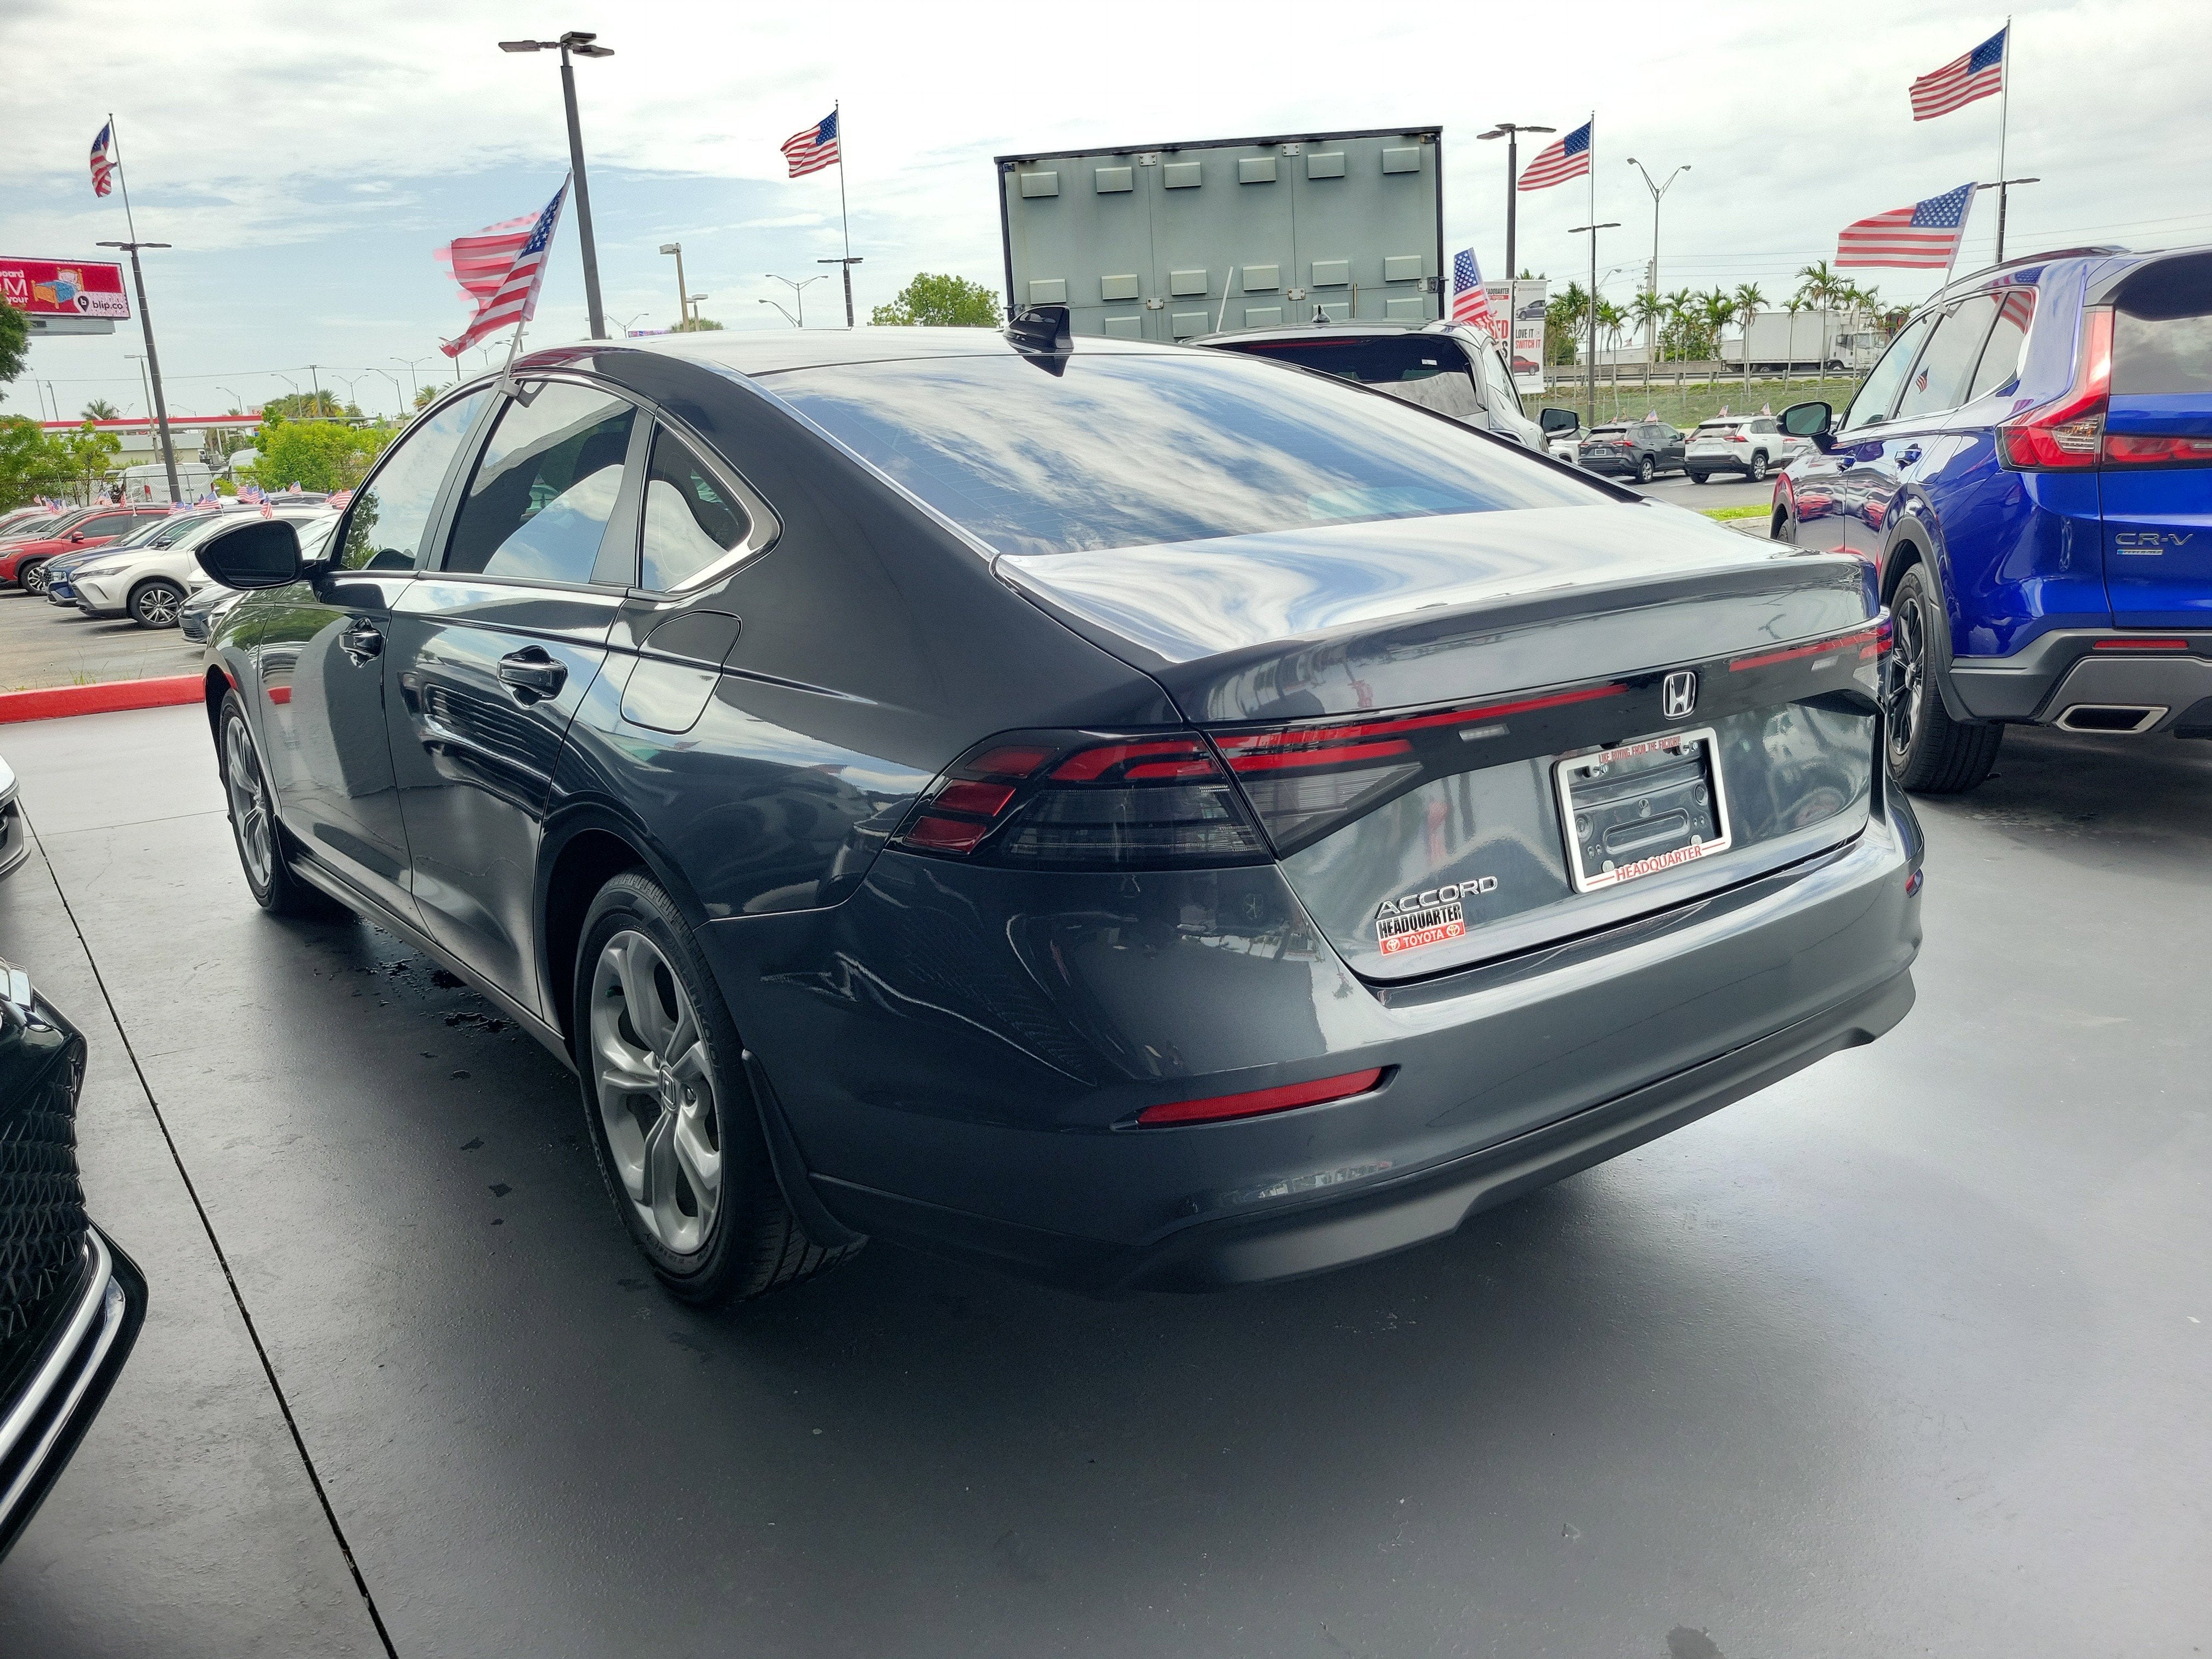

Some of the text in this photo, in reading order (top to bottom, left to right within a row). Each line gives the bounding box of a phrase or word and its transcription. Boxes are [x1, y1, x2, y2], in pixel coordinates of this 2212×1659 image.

[5, 296, 29, 304] your
[92, 300, 123, 311] blip.co
[1488, 319, 1508, 340] SED
[1515, 329, 1528, 338] LOVE
[1528, 329, 1534, 338] IT
[1515, 340, 1541, 349] SWITCH IT
[2115, 533, 2193, 546] CR-V
[1599, 735, 1681, 764] LIKE BUYING FROM THE FACTORY!
[1615, 845, 1702, 881] HEADQUARTER
[1375, 876, 1498, 918] ACCORD
[1378, 905, 1462, 939] HEADQUARTER
[1403, 929, 1444, 948] TOYOTA
